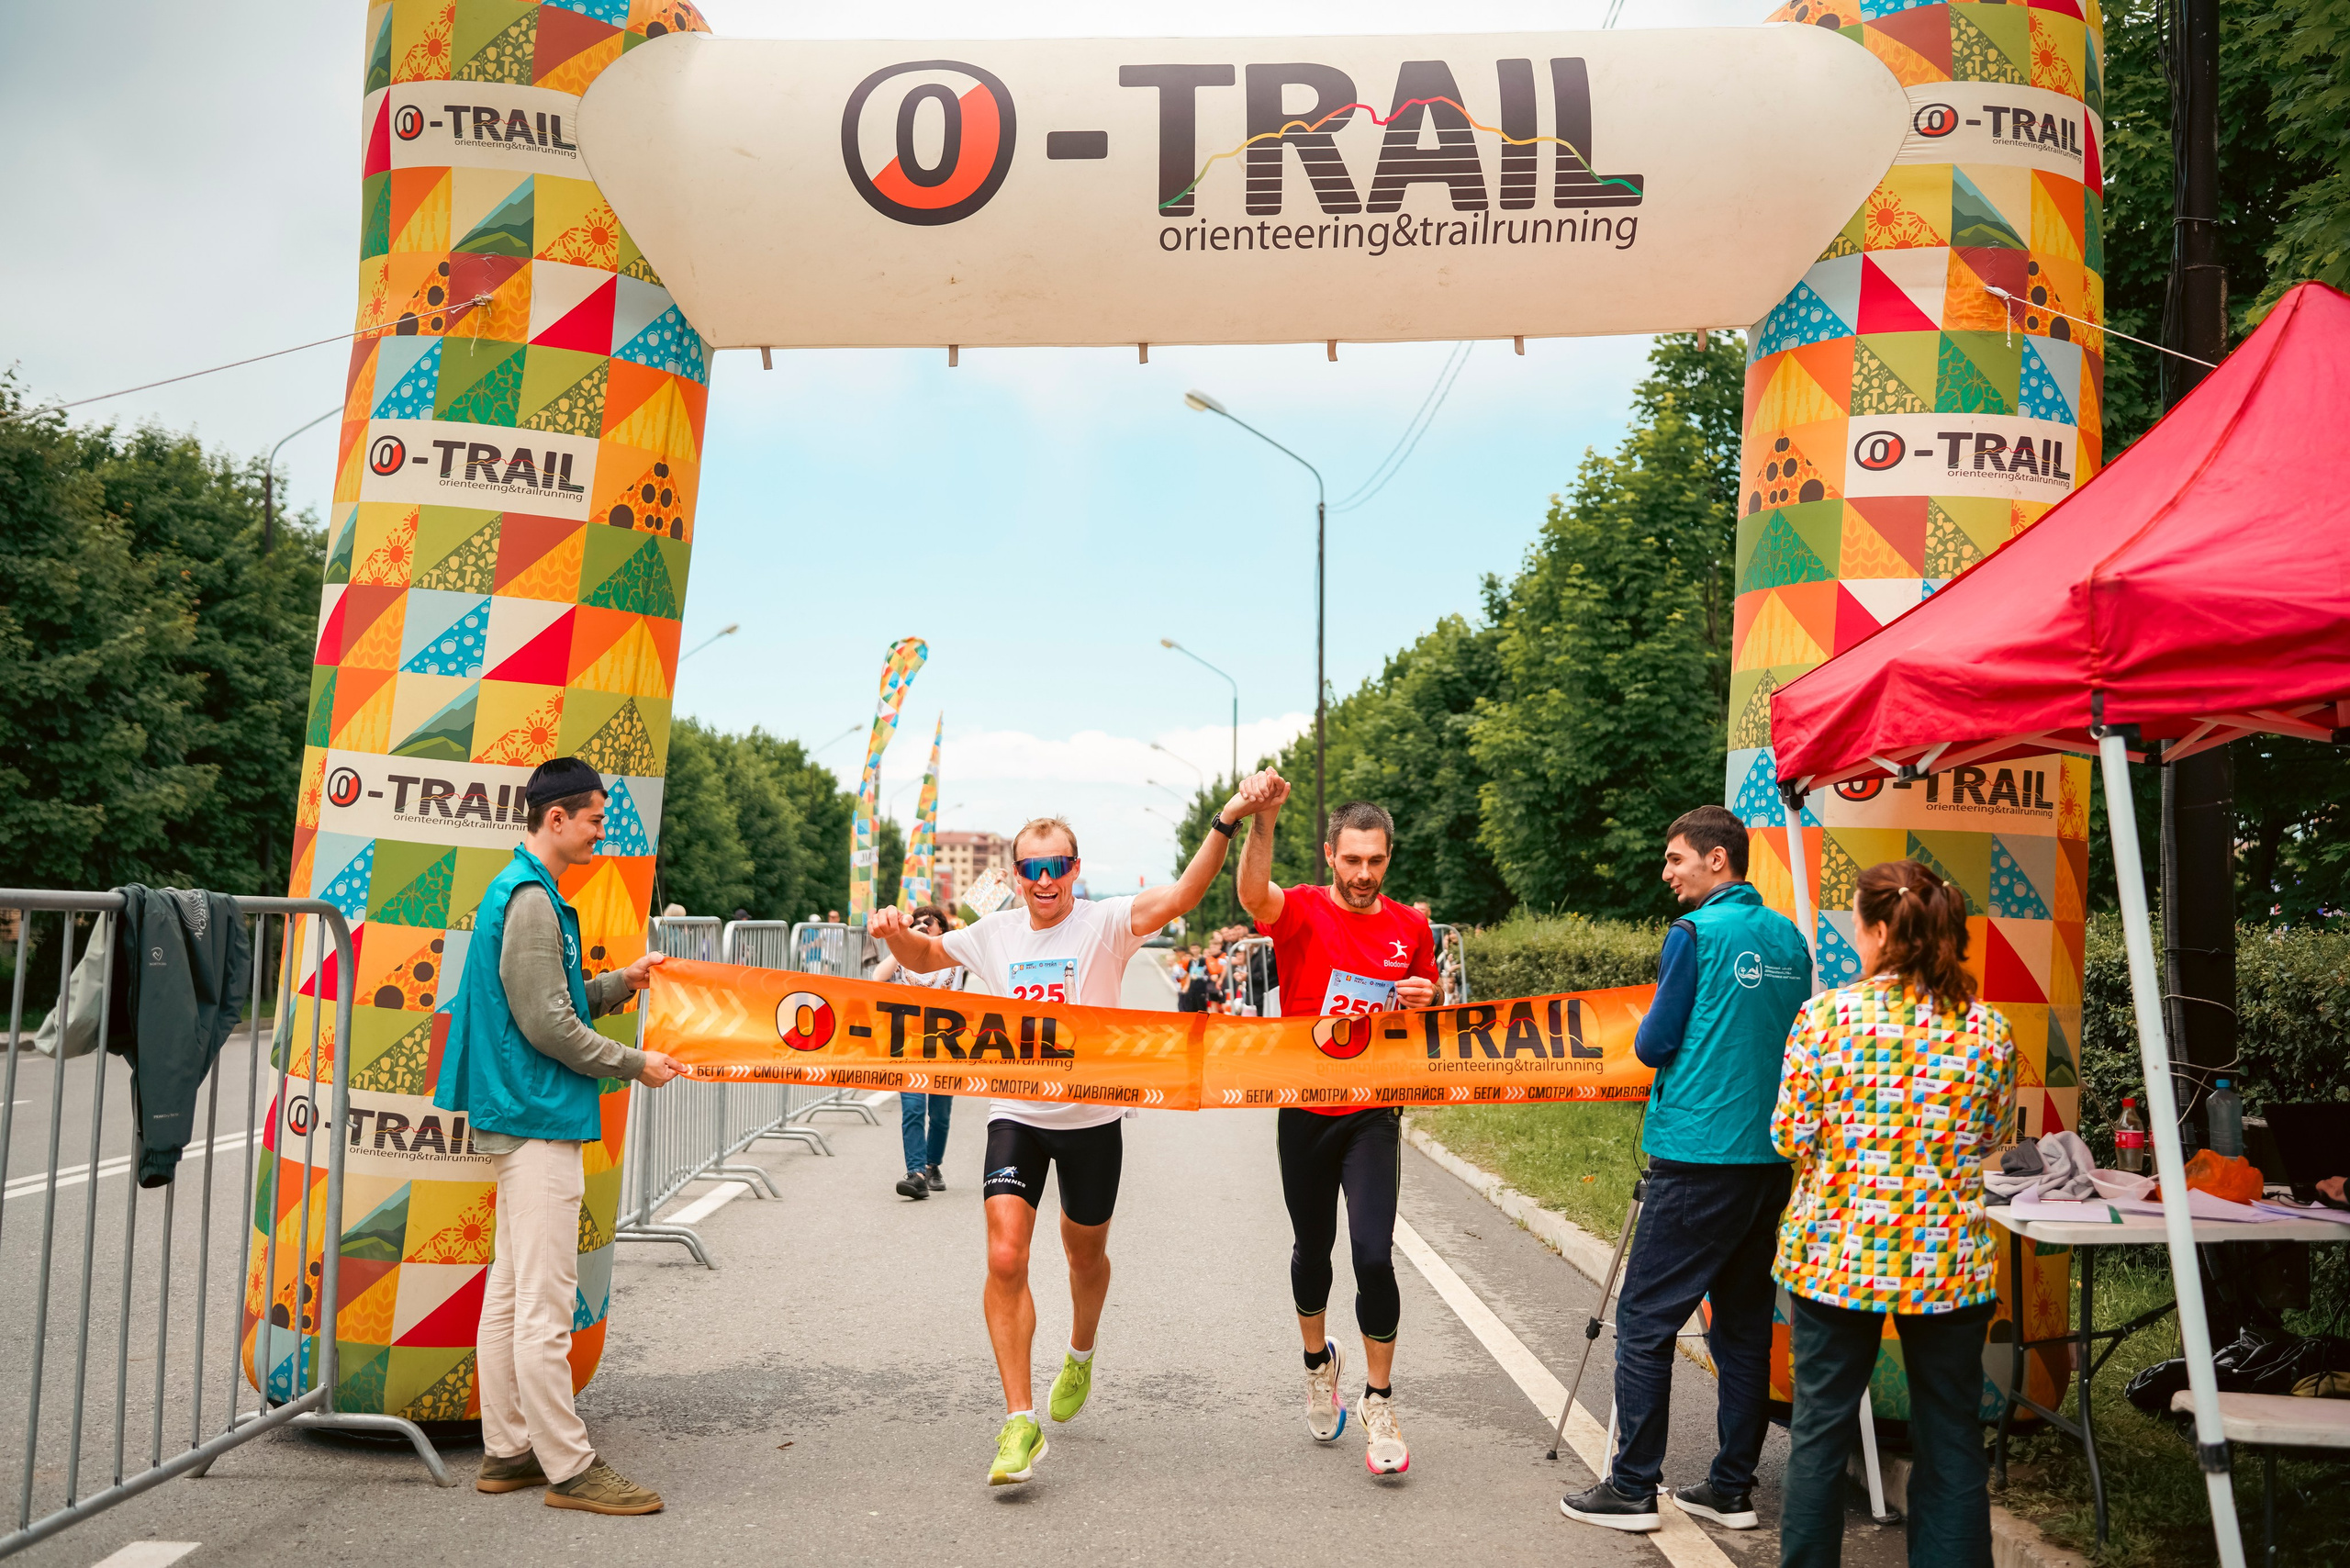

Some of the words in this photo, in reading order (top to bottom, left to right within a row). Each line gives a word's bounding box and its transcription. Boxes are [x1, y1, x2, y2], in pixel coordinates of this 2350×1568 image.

[454, 138, 577, 160] orienteering&trailrunning
[1992, 138, 2082, 164] orienteering&trailrunning
[1159, 210, 1639, 256] orienteering&trailrunning
[1947, 469, 2070, 490] orienteering&trailrunning
[439, 479, 584, 503] orienteering&trailrunning
[1926, 802, 2053, 820] orienteering&trailrunning
[393, 812, 529, 832] orienteering&trailrunnin
[1013, 983, 1066, 1004] 225
[1428, 1058, 1604, 1075] orienteering&trailrunning
[697, 1065, 724, 1078] БЕГИ
[753, 1065, 802, 1081] СМОТРИ
[830, 1069, 903, 1087] УДИВЛЯЙСЯ
[934, 1075, 962, 1091] БЕГИ
[990, 1078, 1039, 1095] СМОТРИ
[1067, 1083, 1139, 1103] УДИВЛЯЙСЯ
[1246, 1089, 1273, 1103] БЕГИ
[1301, 1088, 1348, 1103] СМОТРИ
[1375, 1084, 1445, 1102] УДИВЛЯЙСЯ
[1473, 1086, 1501, 1100] БЕГИ
[1528, 1085, 1574, 1099] СМОТРИ
[1600, 1083, 1652, 1100] УДИВЛЯЙ
[349, 1147, 492, 1165] orienteering&trailrunning
